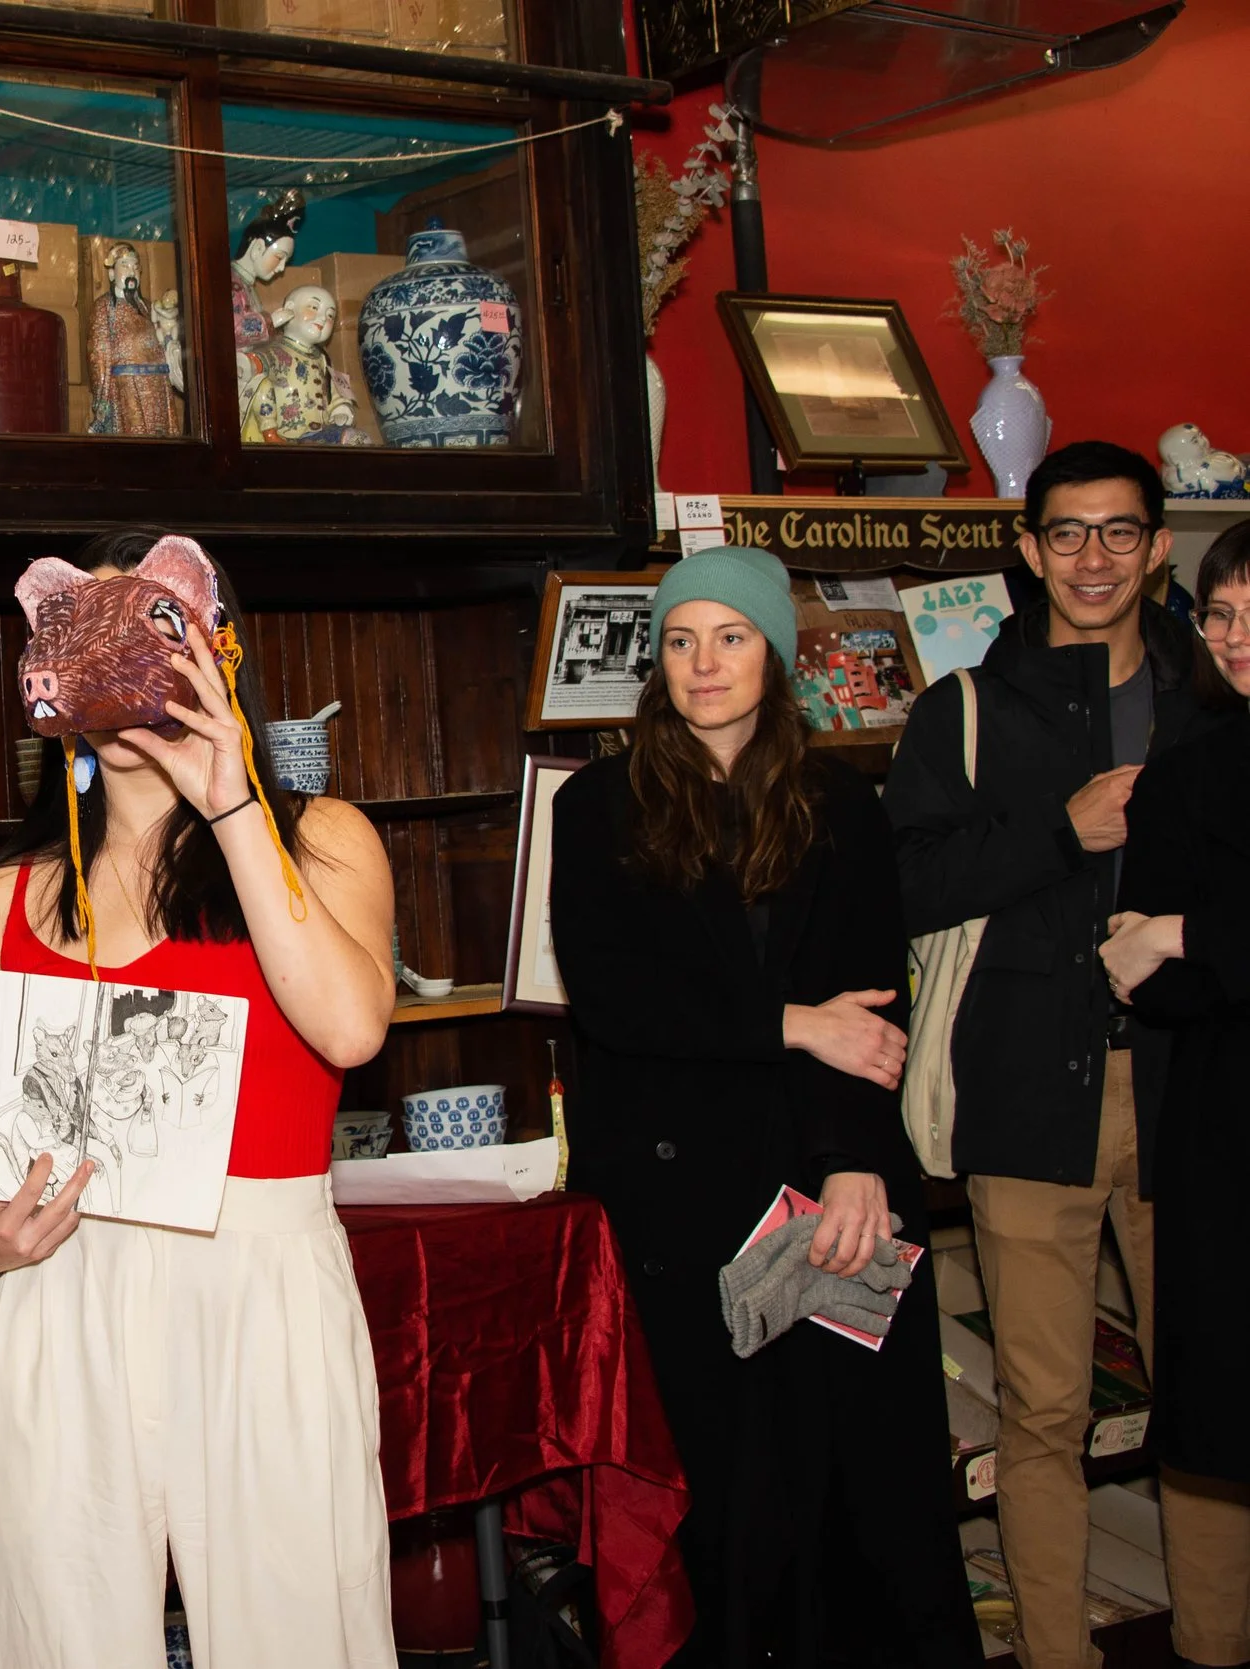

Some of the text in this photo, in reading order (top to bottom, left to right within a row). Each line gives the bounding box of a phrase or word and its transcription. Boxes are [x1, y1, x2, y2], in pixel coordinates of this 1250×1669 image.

[780, 510, 910, 549] Carolina
[920, 513, 1003, 549] Scent
[922, 581, 986, 611] LAZY
